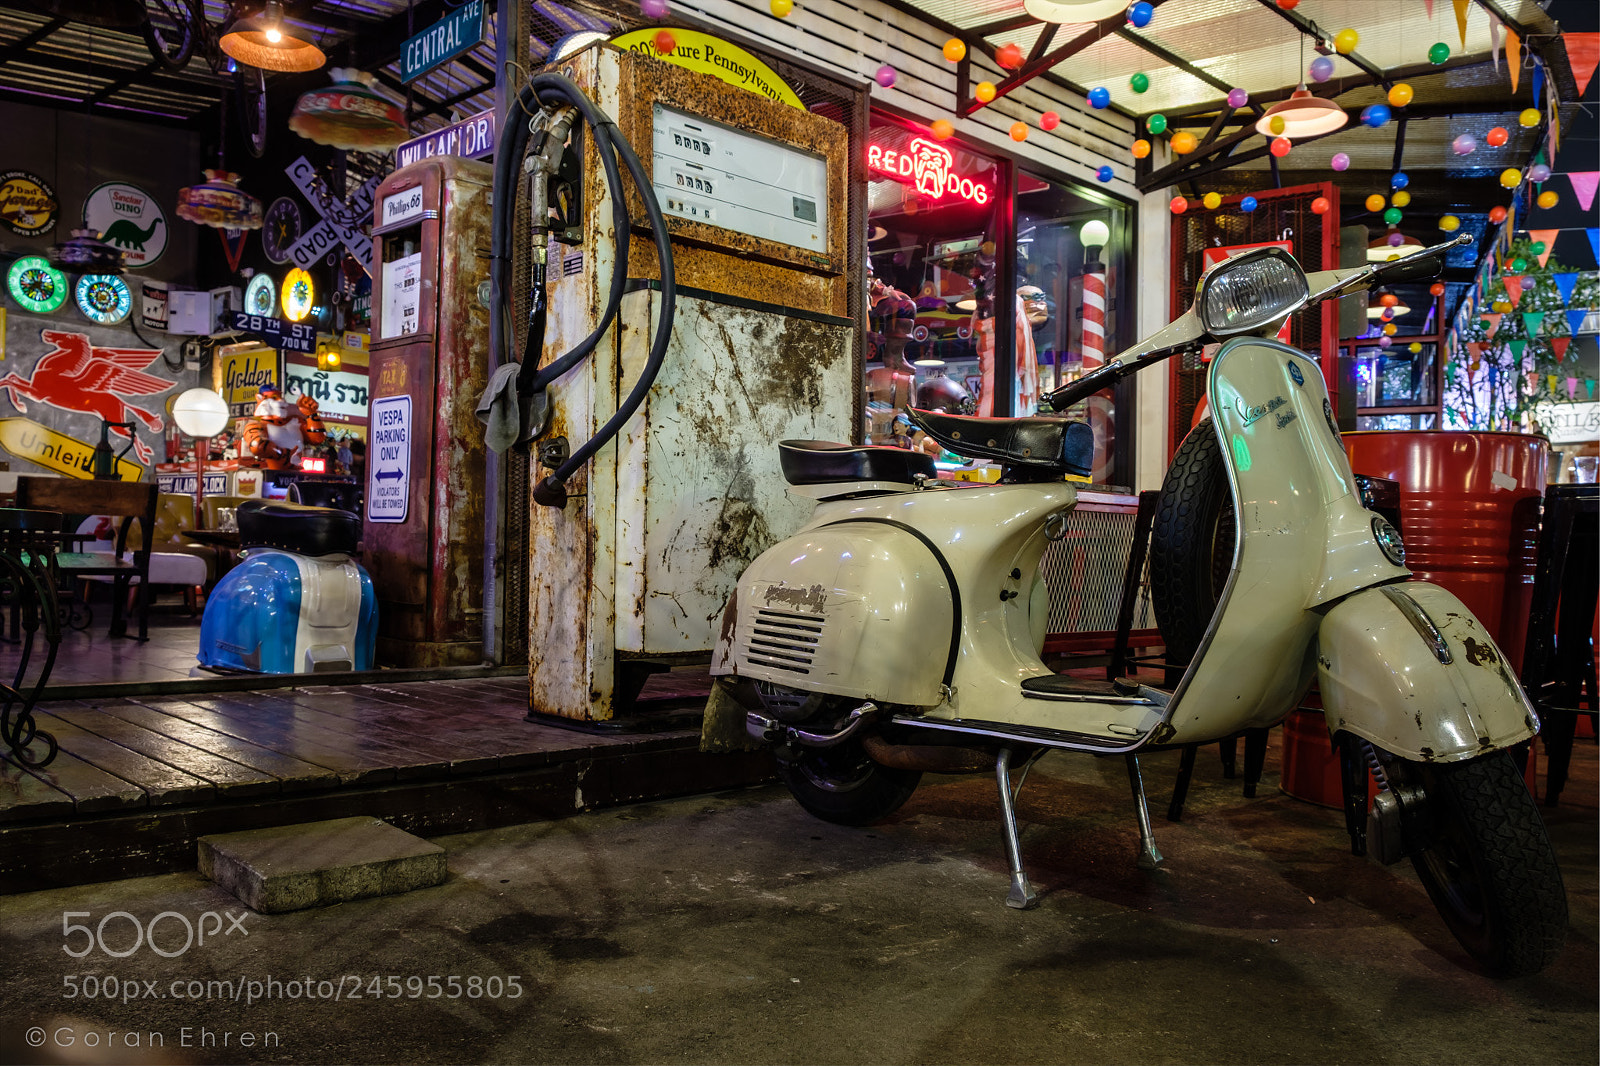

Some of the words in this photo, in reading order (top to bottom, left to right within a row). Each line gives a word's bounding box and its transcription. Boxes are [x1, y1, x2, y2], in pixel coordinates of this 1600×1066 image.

[407, 17, 462, 73] CENTRAL
[463, 0, 480, 22] AVE
[868, 145, 913, 176] RED
[947, 173, 988, 205] DOG
[114, 202, 141, 214] DINO
[387, 199, 410, 217] Phillips
[410, 193, 421, 208] 66
[294, 223, 338, 265] ROAD
[236, 313, 280, 334] 28TH
[291, 323, 314, 340] ST.
[281, 336, 300, 349] 700
[226, 357, 275, 402] Golden
[379, 409, 404, 426] VESPA
[376, 428, 406, 445] PARKING
[380, 446, 400, 461] ONLY
[376, 486, 400, 497] VIOLATORS
[372, 500, 382, 509] WILL
[382, 499, 387, 508] BE
[387, 498, 403, 509] TOWED
